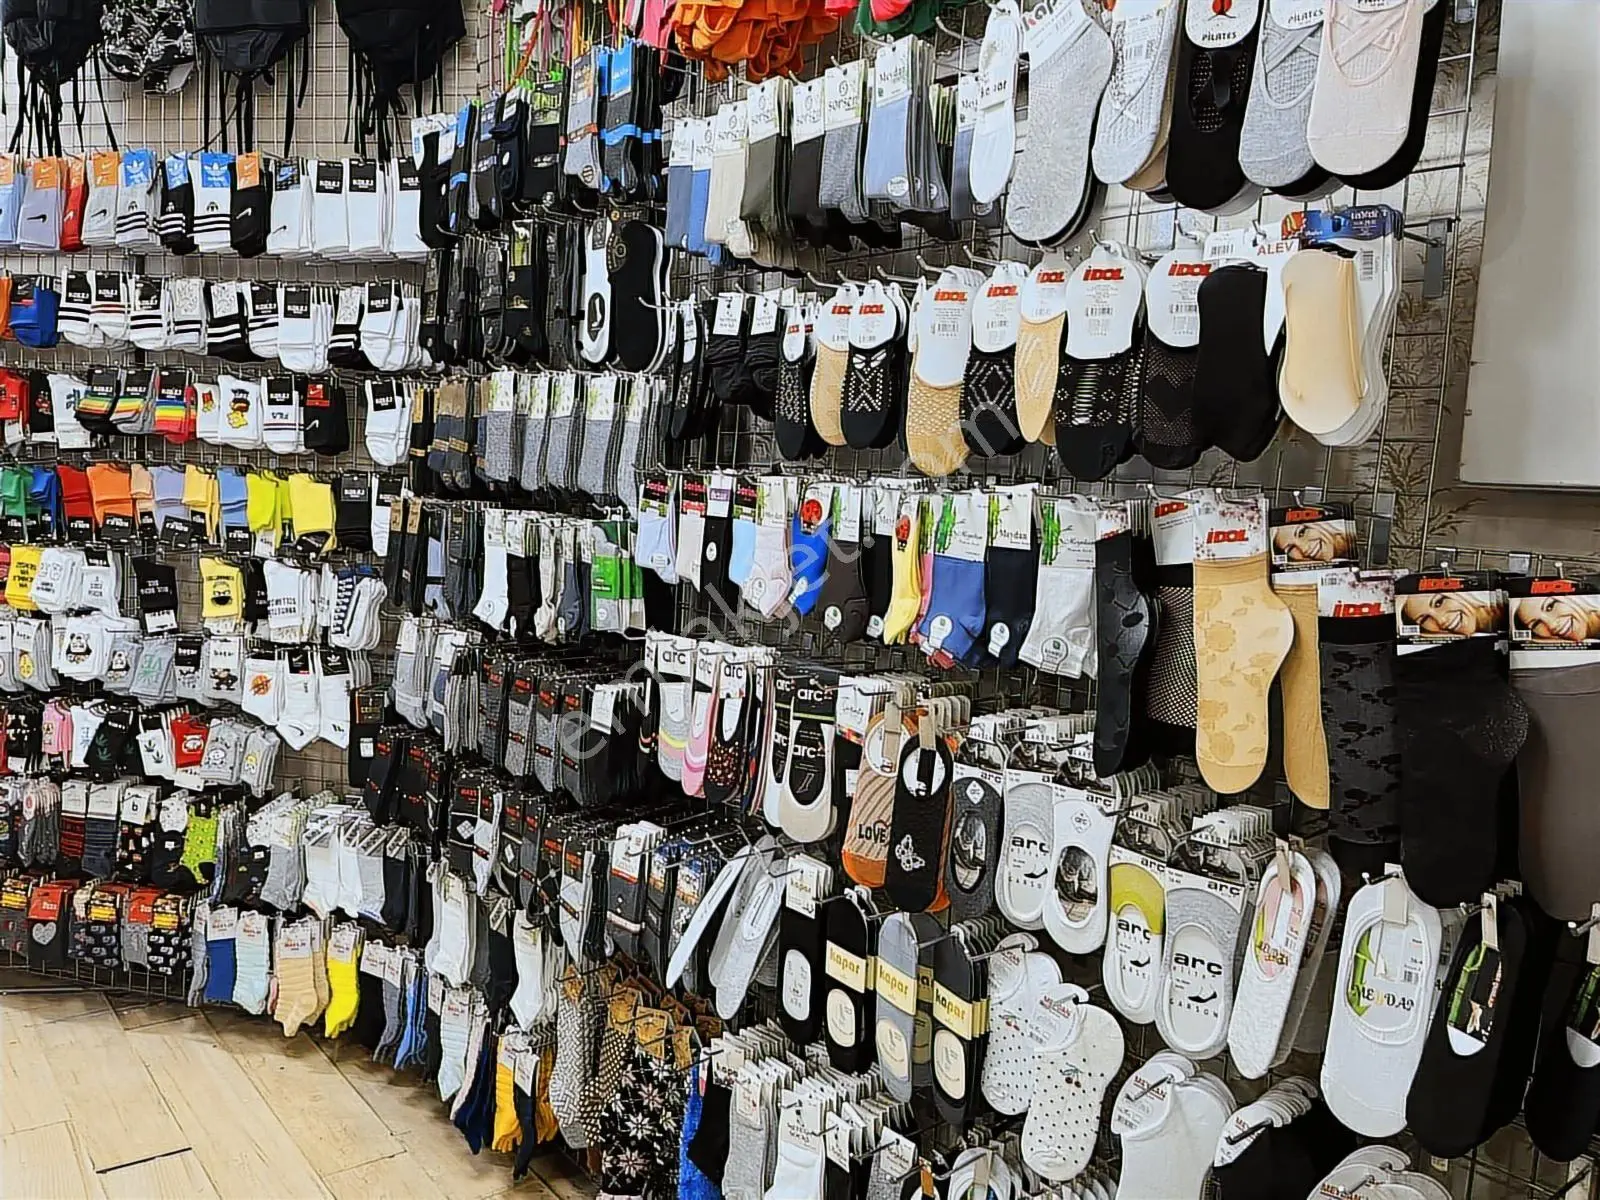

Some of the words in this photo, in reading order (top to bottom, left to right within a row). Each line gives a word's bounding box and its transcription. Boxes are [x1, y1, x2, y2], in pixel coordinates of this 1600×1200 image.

[1257, 241, 1293, 256] ALEV
[662, 651, 686, 664] arc
[698, 658, 712, 674] arc
[723, 664, 743, 680] arc
[776, 679, 791, 692] arc
[797, 688, 823, 702] arc
[774, 731, 788, 747] arc
[792, 744, 817, 758] arc
[980, 771, 1002, 784] arc
[1086, 793, 1113, 807] arc
[858, 822, 887, 844] LOVE
[1012, 836, 1050, 854] arc
[1140, 857, 1166, 873] arc
[1207, 881, 1241, 896] arc
[1117, 919, 1152, 941] arc
[1173, 952, 1223, 976] arc
